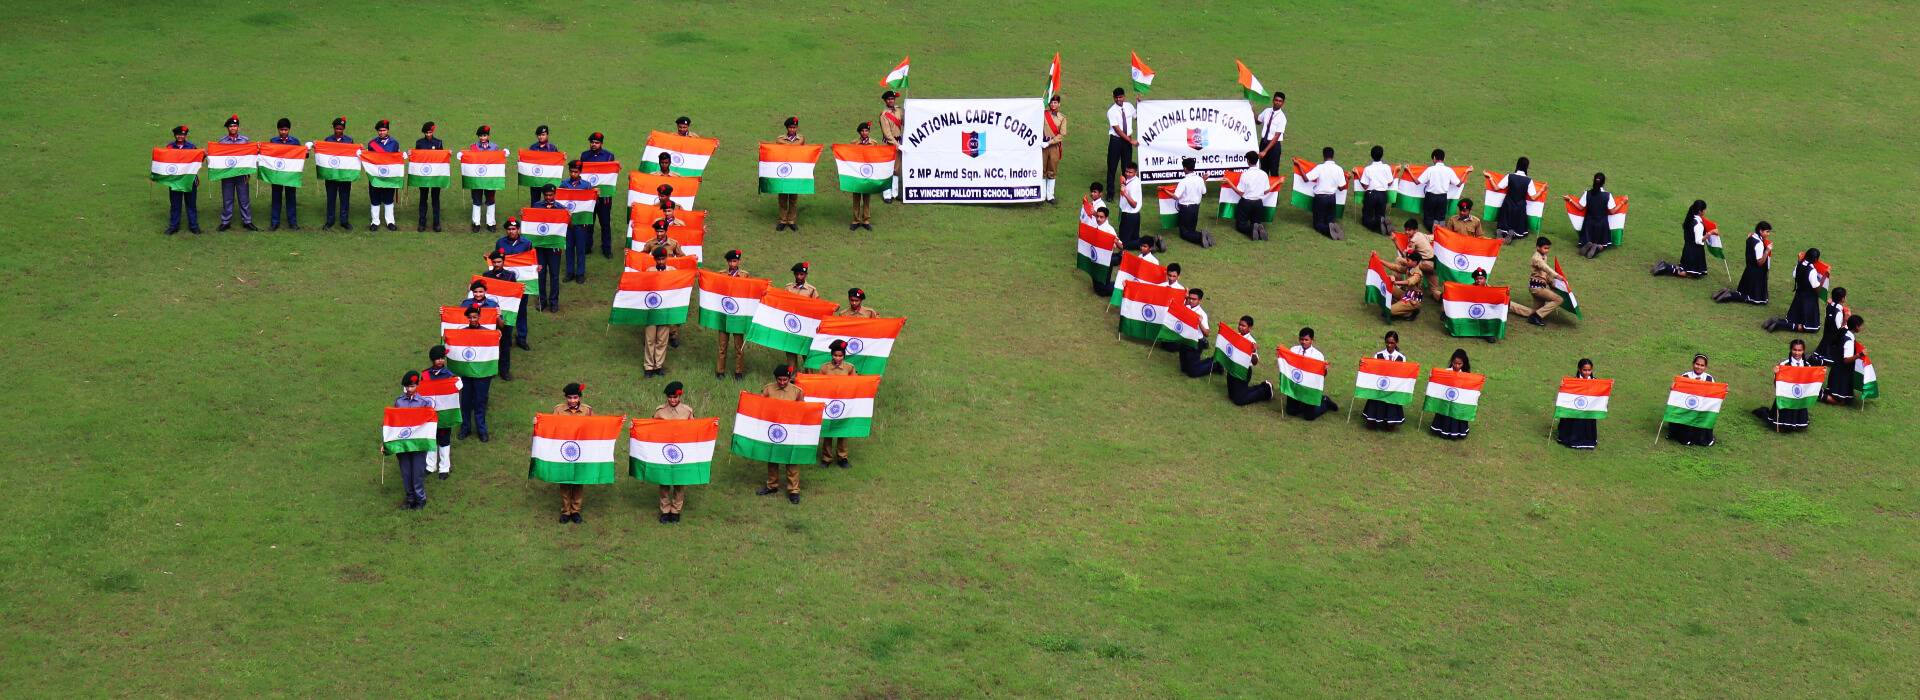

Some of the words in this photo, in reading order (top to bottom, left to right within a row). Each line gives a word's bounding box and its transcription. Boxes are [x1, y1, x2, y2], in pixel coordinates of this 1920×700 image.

[908, 111, 962, 147] NATIONAL
[965, 109, 1002, 125] CADET
[1004, 115, 1038, 147] CORPS
[1142, 108, 1187, 146] NATIONAL
[1189, 107, 1219, 124] CADET
[1222, 113, 1252, 142] CORPS
[1144, 158, 1149, 166] 1
[1152, 157, 1164, 166] MP
[1167, 156, 1179, 165] Air
[1202, 155, 1223, 165] NCC,
[1225, 154, 1249, 163] Indor
[909, 169, 915, 179] 2
[917, 169, 932, 179] MP
[934, 168, 958, 179] Armd
[961, 168, 981, 181] Sqn.
[984, 168, 1007, 180] NCC,
[1009, 168, 1038, 178] Indore
[1151, 171, 1177, 180] VINCENT
[908, 189, 919, 198] ST.
[919, 189, 950, 198] VINCENT
[950, 188, 982, 198] PALLOTTI
[982, 188, 1013, 199] SCHOOL,
[1013, 188, 1038, 198] INDORE
